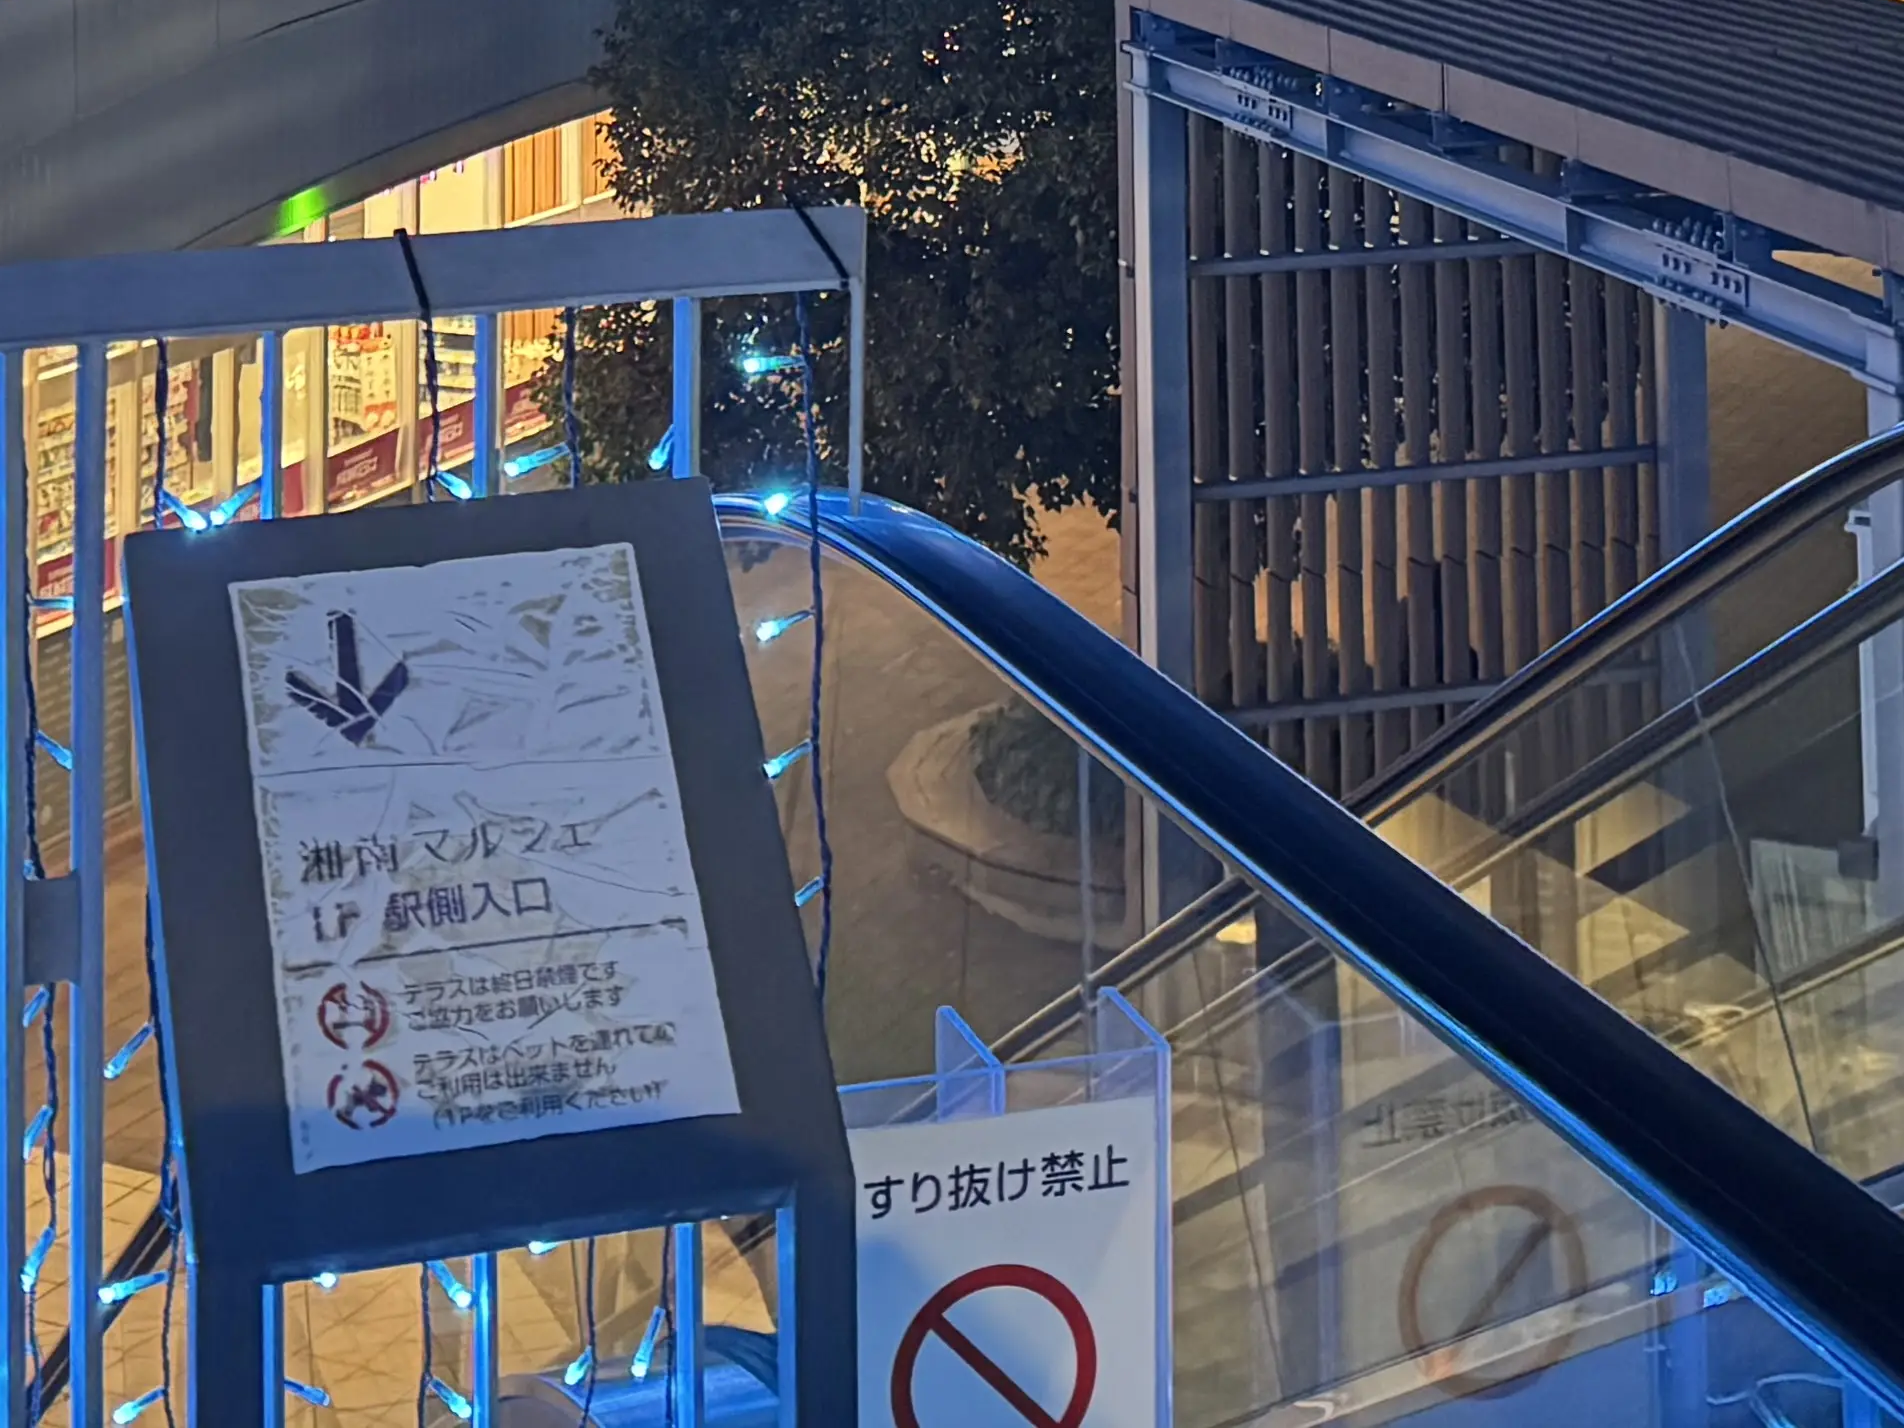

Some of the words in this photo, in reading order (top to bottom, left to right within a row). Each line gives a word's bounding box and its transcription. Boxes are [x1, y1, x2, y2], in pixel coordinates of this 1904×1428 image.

[864, 1144, 1129, 1220] すり抜け禁止
